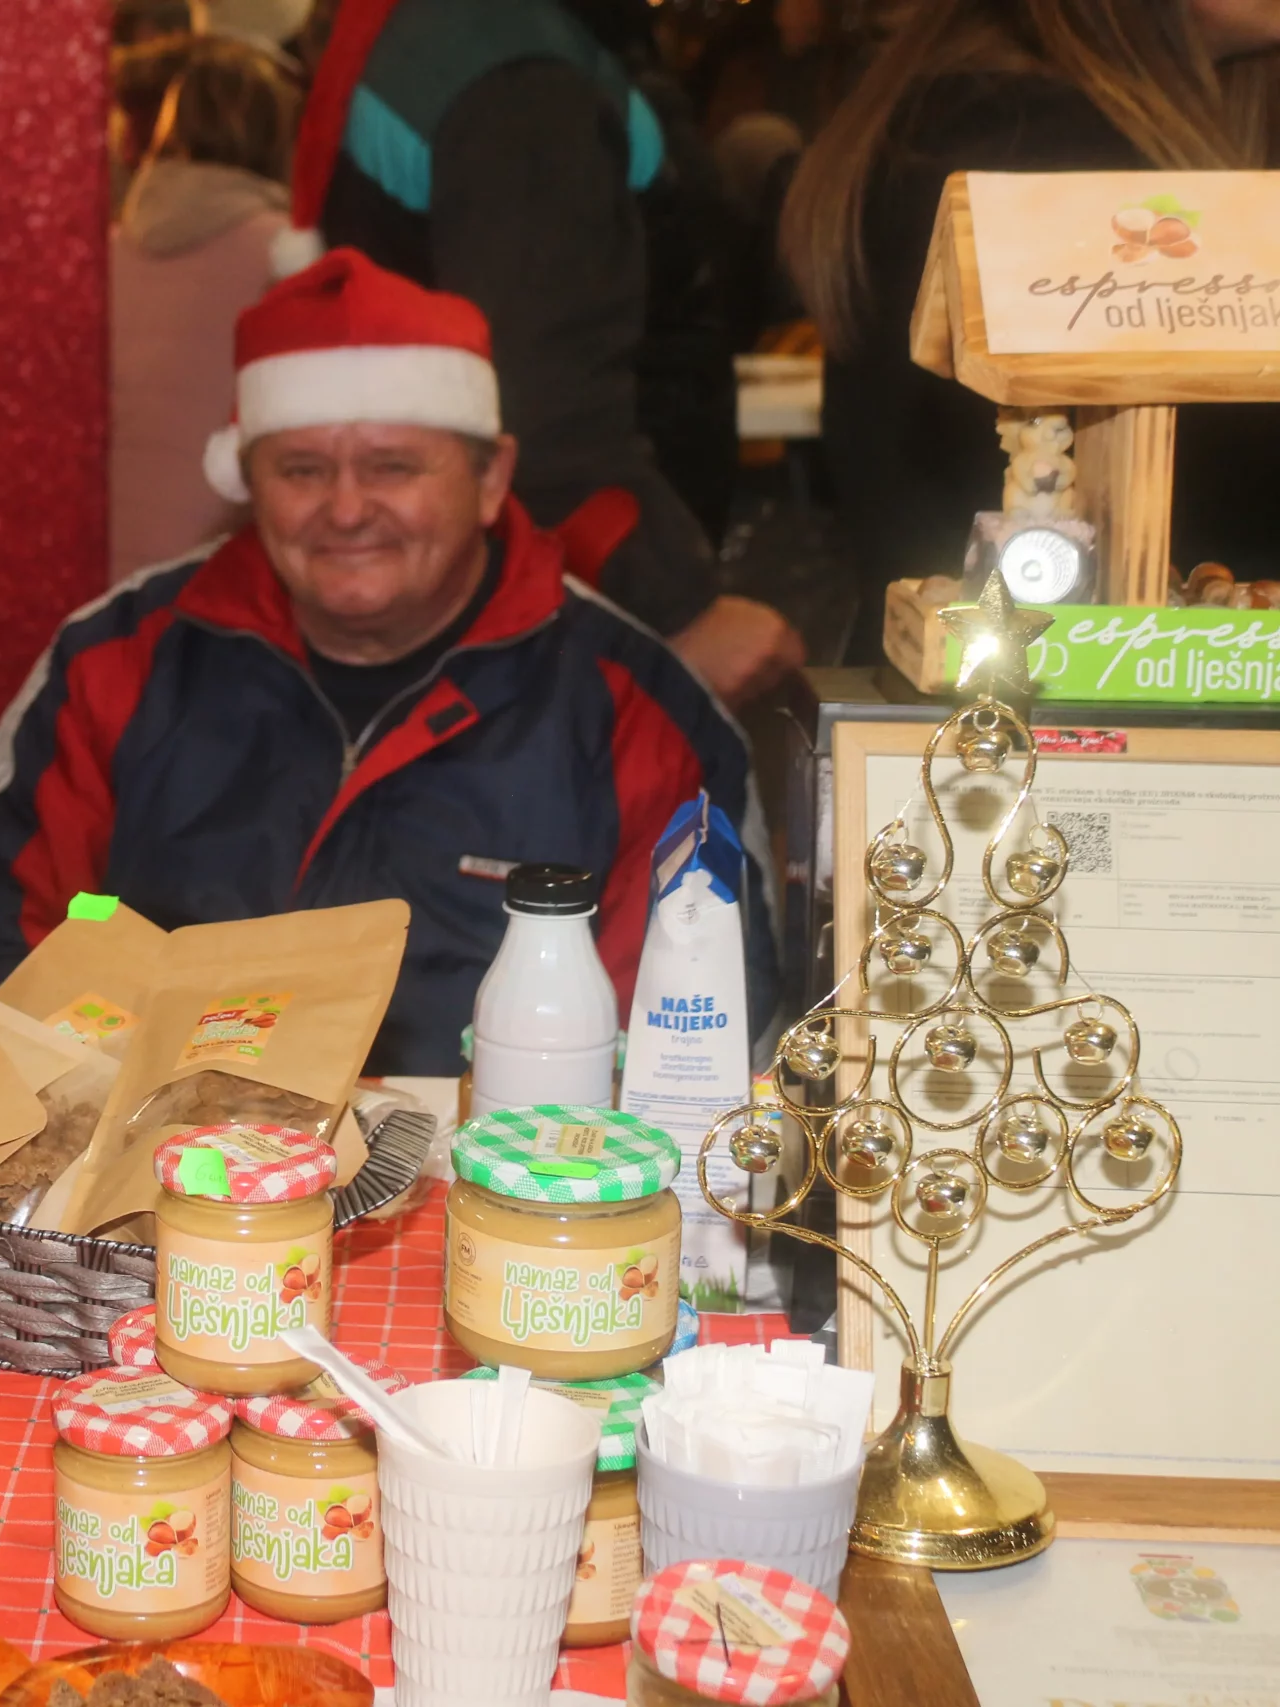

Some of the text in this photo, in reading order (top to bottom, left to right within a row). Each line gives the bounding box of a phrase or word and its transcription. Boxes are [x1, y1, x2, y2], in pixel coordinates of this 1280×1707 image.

[1105, 297, 1146, 328] od
[1135, 648, 1176, 688] od
[647, 1011, 728, 1032] MLIJEKO
[661, 994, 714, 1013] NAŠE
[169, 1253, 274, 1294] namaz od
[504, 1259, 581, 1291] namaz
[587, 1262, 614, 1292] od
[167, 1282, 307, 1352] Lješnjaka
[501, 1288, 645, 1346] Lješnjaka
[58, 1497, 138, 1545] amaz od
[286, 1498, 314, 1529] od
[58, 1527, 177, 1598] ješnjaka
